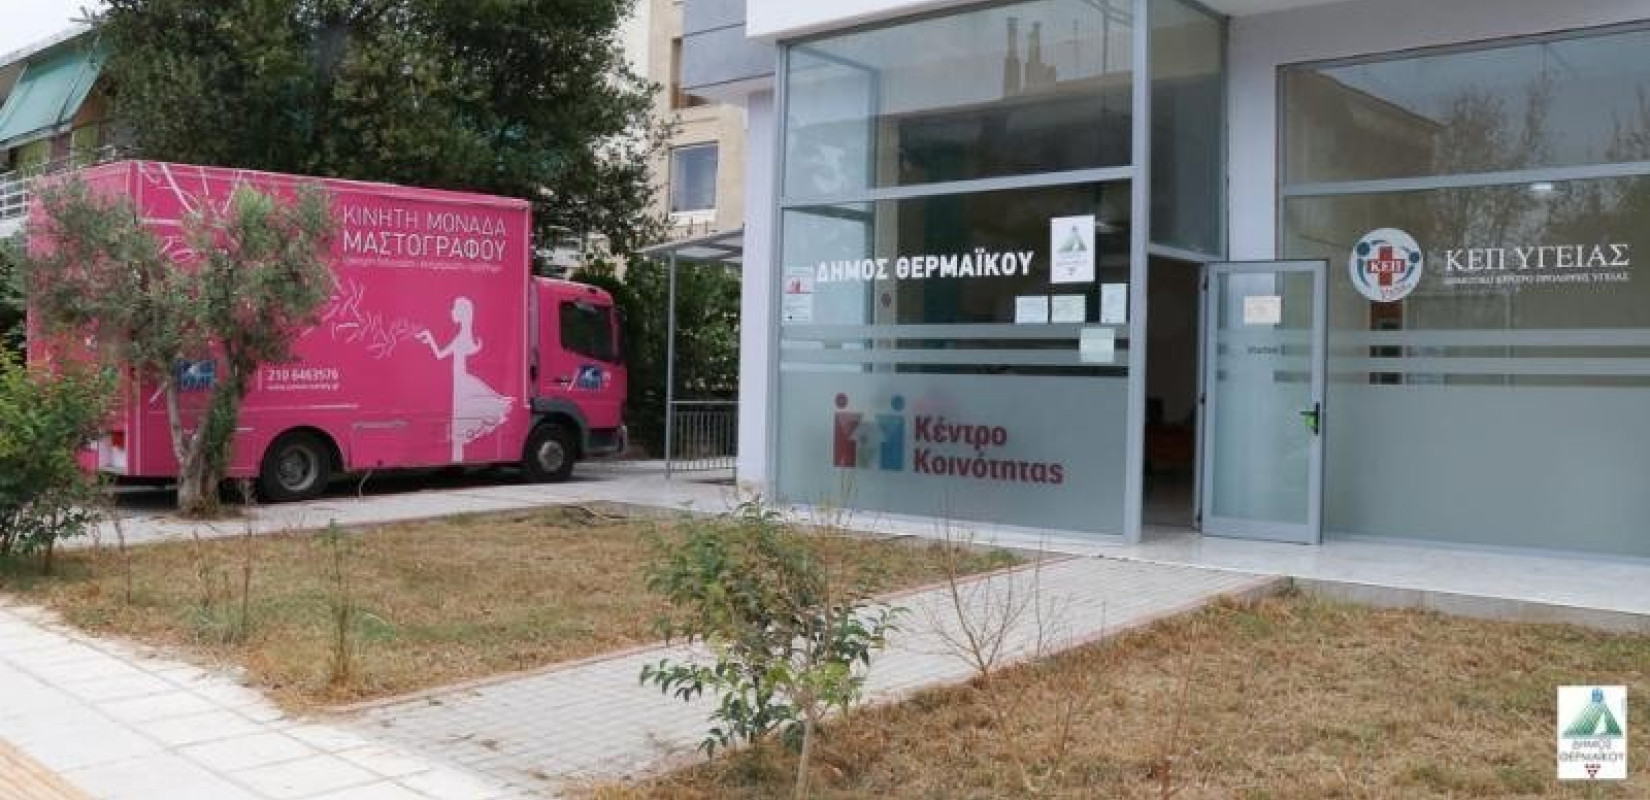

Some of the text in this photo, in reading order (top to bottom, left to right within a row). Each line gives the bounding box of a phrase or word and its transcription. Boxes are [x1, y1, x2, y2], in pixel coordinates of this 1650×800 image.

[343, 204, 506, 237] ΚΙΝΗΤΗ ΜΟΝΑΔΑ
[343, 229, 507, 262] ΜΑΣΤΟΓΡΑΦΟΥ
[1446, 243, 1631, 272] ΚΕΠ ΥΓΕΙΑΣ
[815, 258, 890, 283] ΔΗΜΟΣ
[896, 247, 1035, 280] ΘΕΡΜΑΪΚΟΥ
[1370, 260, 1402, 272] ΚΕΠ
[914, 415, 1007, 451] Κέντρο
[913, 448, 1064, 485] Κοινότητας
